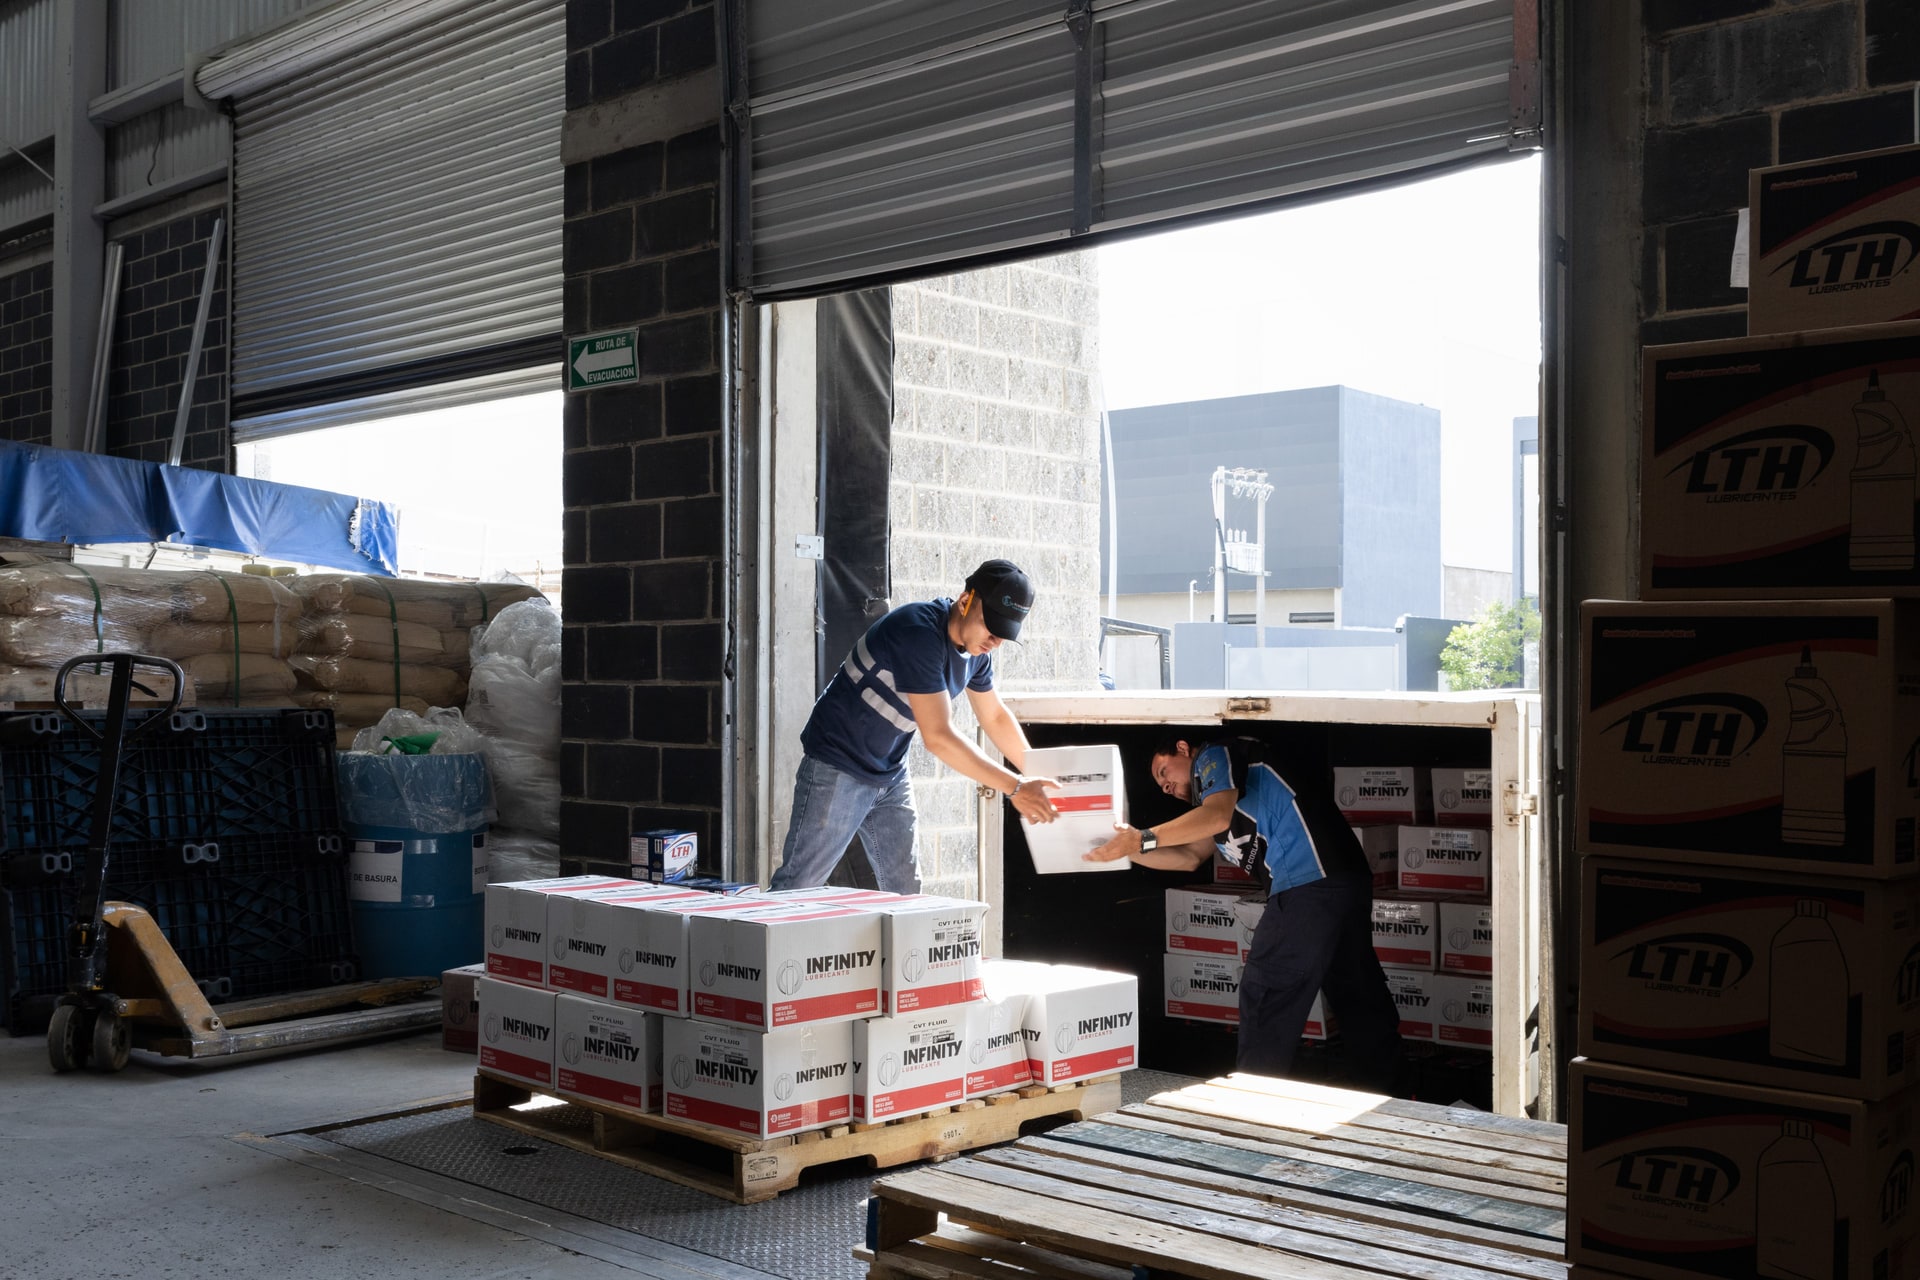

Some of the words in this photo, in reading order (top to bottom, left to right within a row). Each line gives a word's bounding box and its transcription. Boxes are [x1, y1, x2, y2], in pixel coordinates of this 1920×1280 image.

[1789, 238, 1900, 288] LTH
[1808, 278, 1892, 296] LUBRICANTES
[595, 339, 614, 351] RUTA
[616, 337, 626, 346] DE
[588, 367, 634, 383] EVACUACION
[1685, 445, 1809, 494] LTH
[1705, 491, 1797, 504] LUBRICANTES
[1621, 710, 1742, 756] LTH
[1641, 754, 1731, 768] LUBRICANTES
[1359, 786, 1409, 797] INFINITY
[1461, 788, 1492, 800] INFIN
[671, 845, 690, 859] LTH
[1426, 848, 1482, 862] INFINITY
[353, 873, 363, 882] DE
[364, 874, 398, 884] BASURA
[1190, 913, 1235, 928] INFINITY
[505, 927, 541, 944] INFINITY
[568, 938, 606, 957] INFINITY
[928, 940, 980, 963] INFINITY
[635, 950, 677, 968] INFINITY
[806, 949, 876, 975] INFINITY
[927, 959, 962, 970] LUBRICANT
[1628, 943, 1730, 989] LTH
[717, 962, 761, 981] INFINITY
[804, 969, 850, 981] LUBRICANTS
[1190, 978, 1239, 993] INFINITY
[1644, 981, 1721, 998] LUBRICANTES
[1391, 994, 1430, 1007] INITY
[503, 1016, 550, 1041] INFINITY
[928, 1019, 948, 1027] FLUID
[1078, 1011, 1133, 1035] INFINITY
[704, 1034, 717, 1042] CVT
[719, 1037, 740, 1046] FLUID
[1077, 1029, 1113, 1041] LUBRICANTS
[584, 1036, 640, 1062] INFINITY
[903, 1040, 963, 1066] INFINITY
[583, 1053, 619, 1065] LUBRICANTS
[901, 1060, 941, 1073] LUBRICANTS
[695, 1058, 759, 1086] INFINITY
[796, 1062, 848, 1085] INFINITY
[694, 1076, 734, 1089] LUBRICANTS
[1615, 1154, 1717, 1203] LTH
[1632, 1191, 1709, 1213] LUBRICANTES
